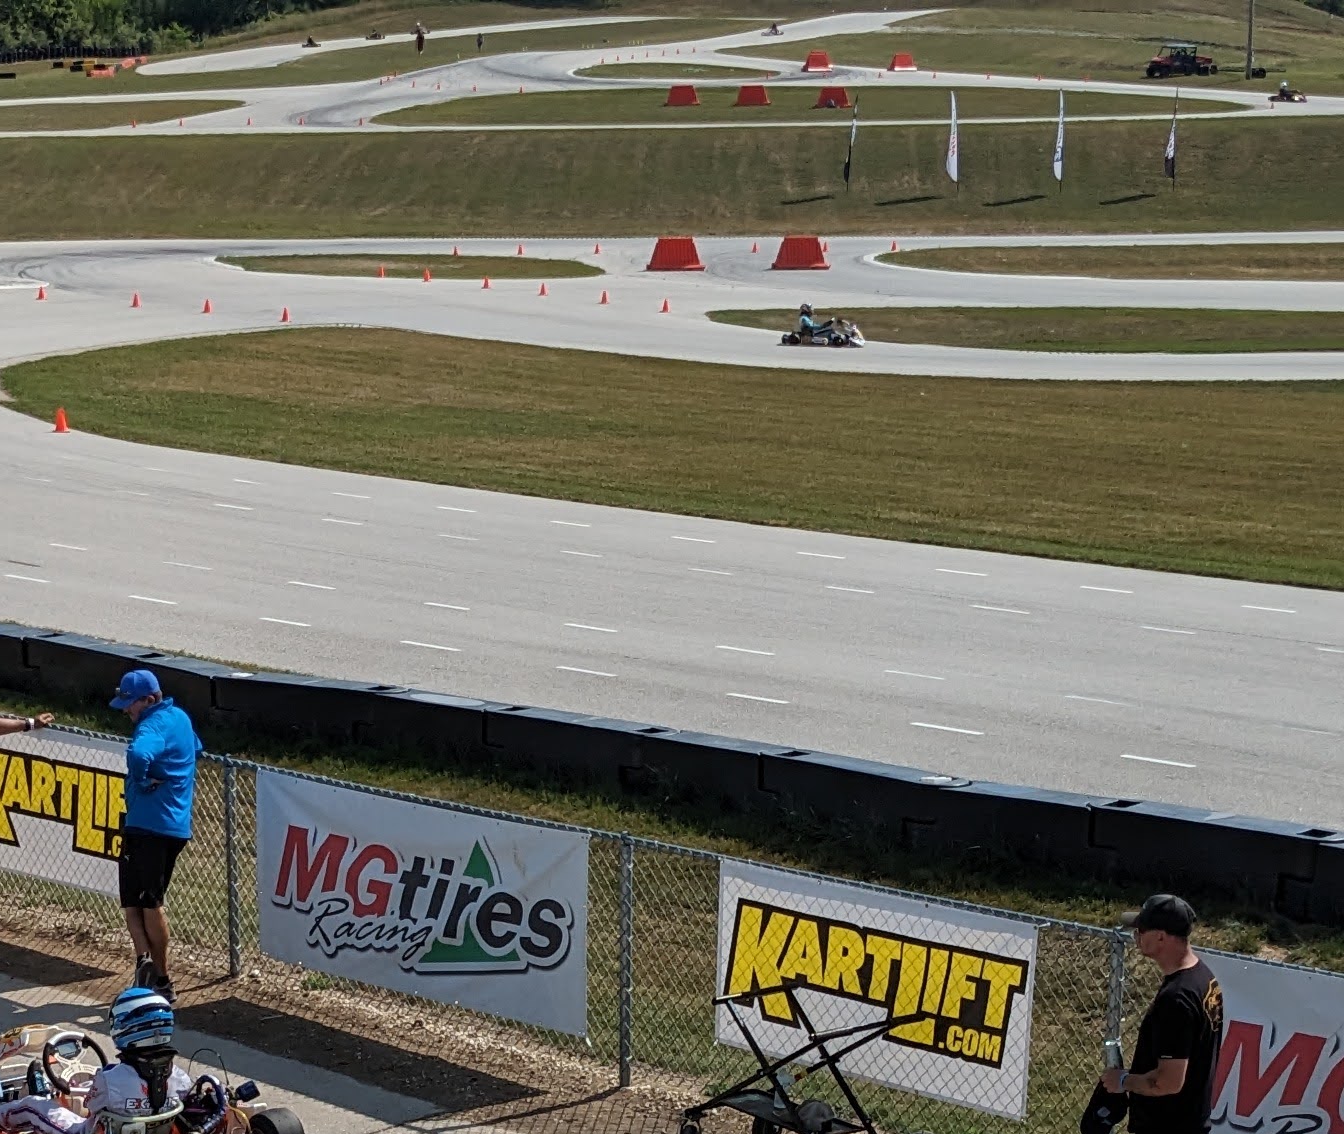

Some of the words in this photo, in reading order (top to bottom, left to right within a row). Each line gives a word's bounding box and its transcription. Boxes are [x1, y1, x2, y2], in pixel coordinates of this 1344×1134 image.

[275, 823, 567, 959] MGtires
[309, 897, 434, 962] Racing
[729, 904, 1024, 1046] KARTLIFT
[938, 1025, 1003, 1063] .COM
